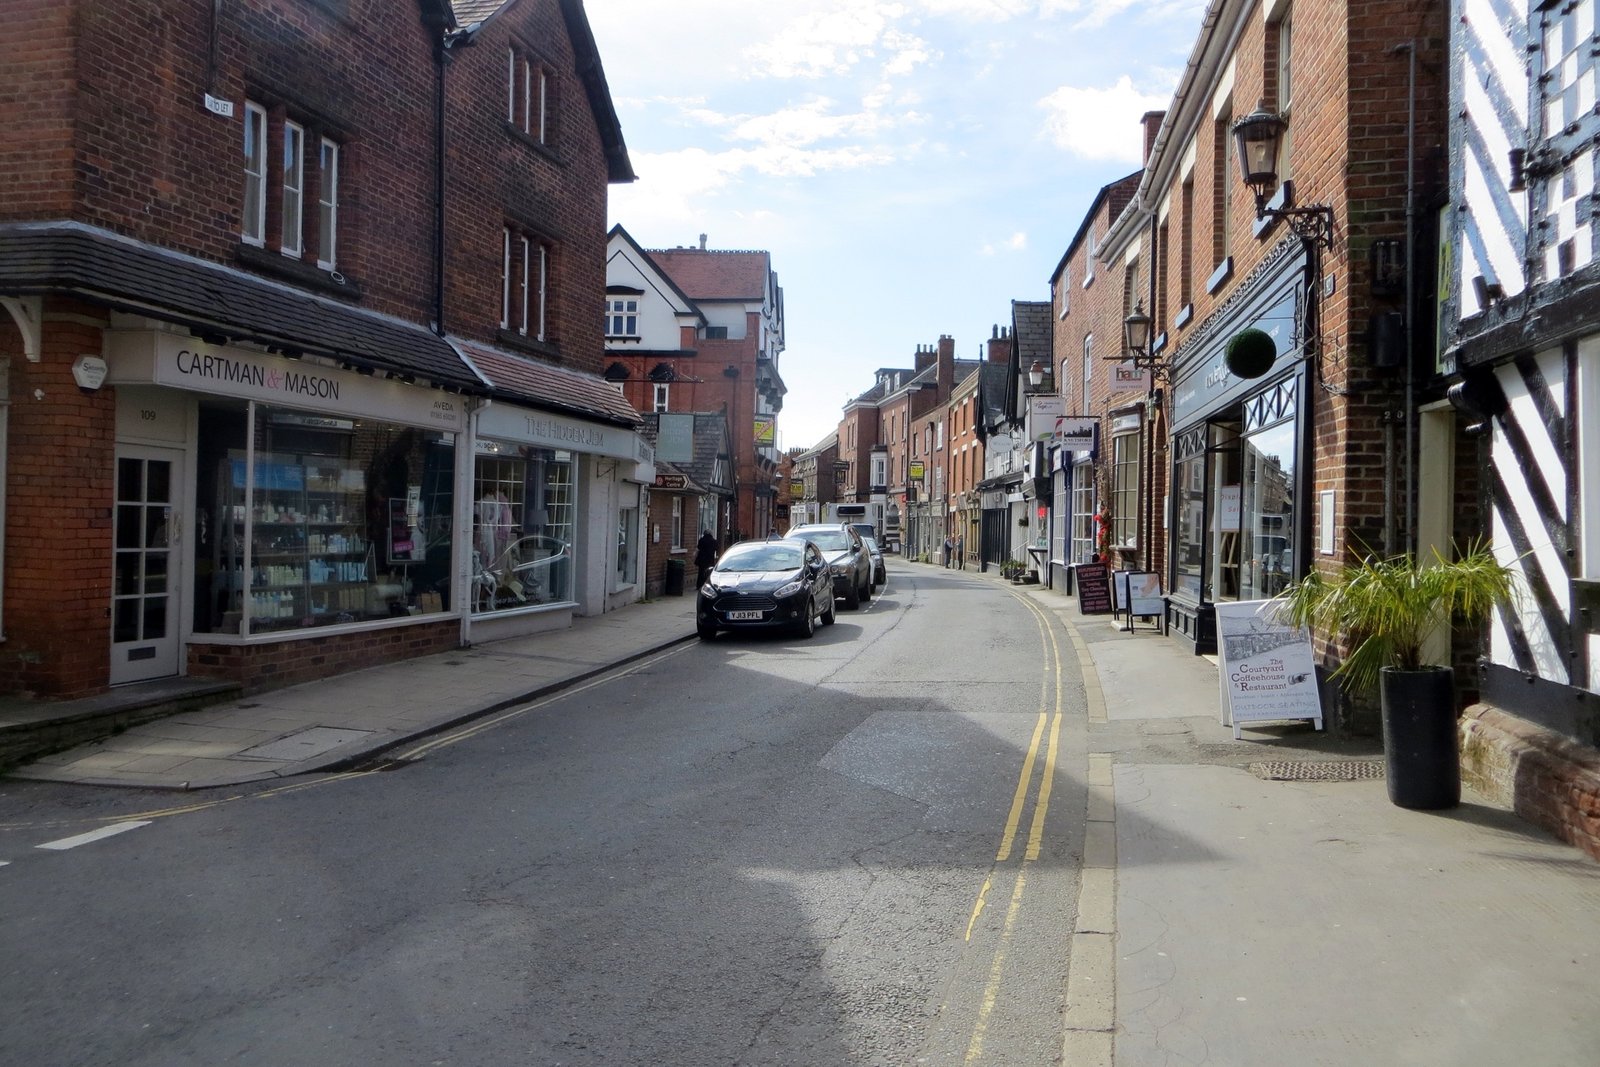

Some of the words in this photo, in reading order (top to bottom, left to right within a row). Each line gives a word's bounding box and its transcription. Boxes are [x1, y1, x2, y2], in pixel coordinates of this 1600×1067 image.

[221, 103, 229, 113] LET
[176, 350, 265, 387] CARTMAN
[266, 367, 284, 390] &
[285, 371, 340, 400] MASON
[433, 401, 454, 411] AVEDA
[140, 409, 157, 421] 109
[524, 415, 547, 438] THE
[548, 420, 585, 444] HIDDEN
[747, 611, 761, 619] PFL
[1239, 664, 1284, 674] Courtyard
[1231, 673, 1286, 682] Coffeehouse
[1241, 682, 1287, 692] Restaurant
[1234, 703, 1275, 711] OUTDOOR
[1277, 700, 1316, 709] SEATING
